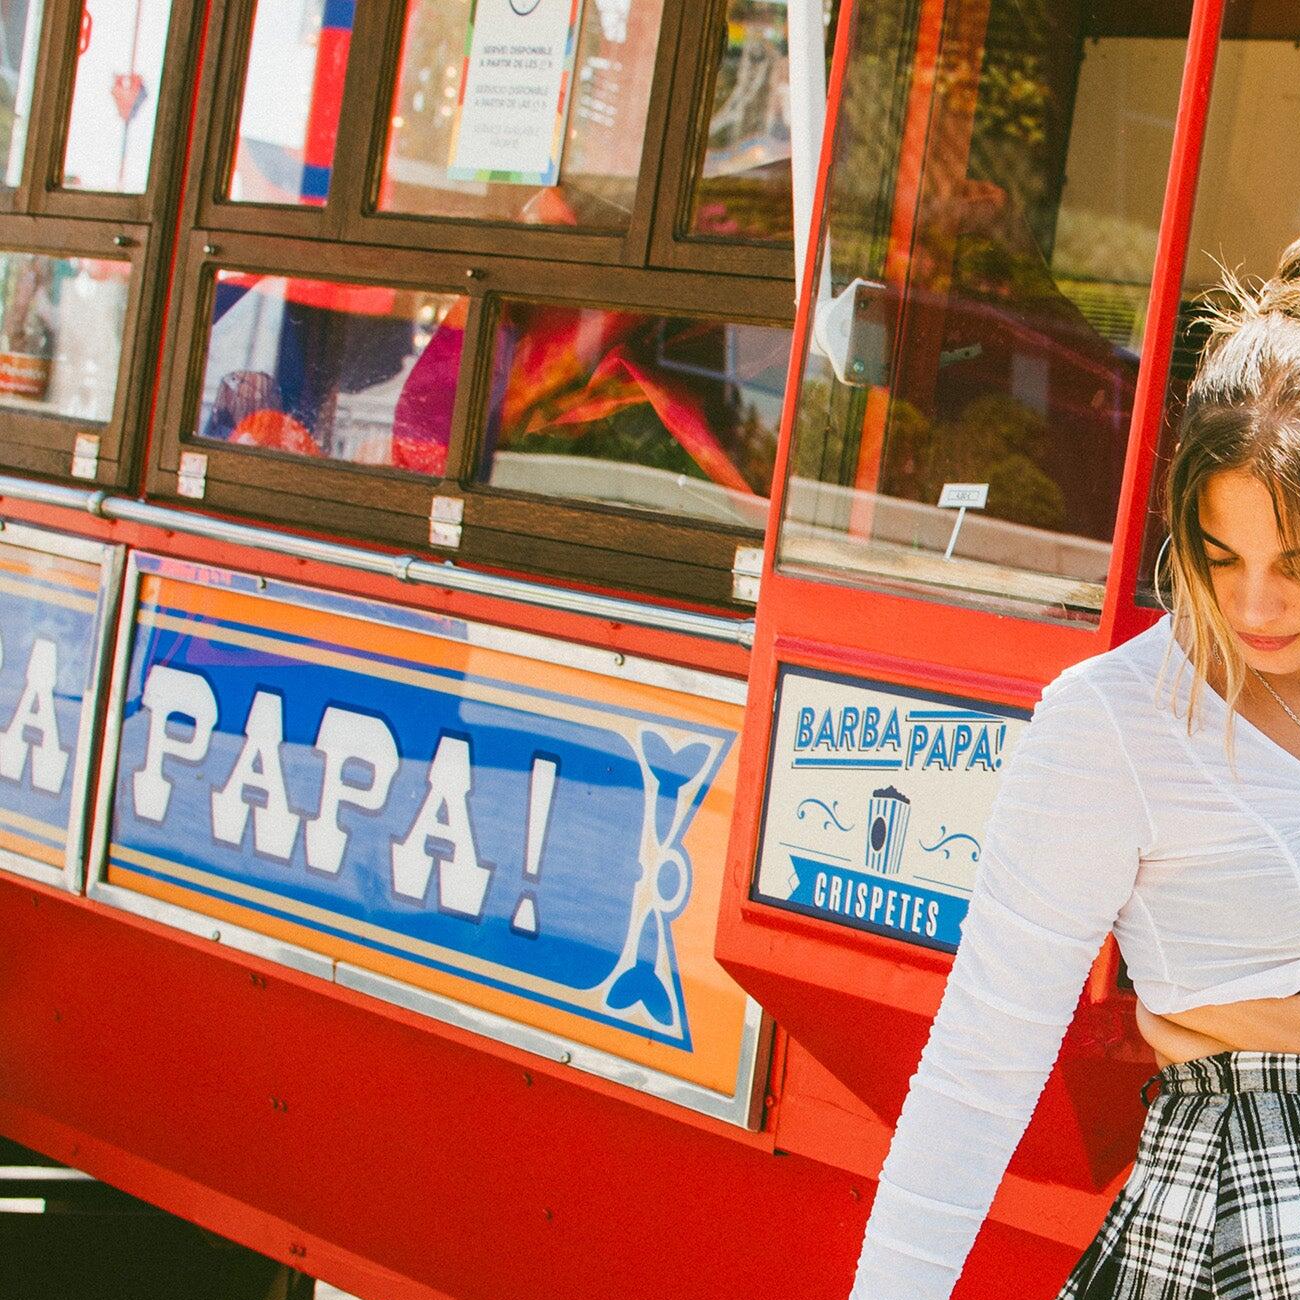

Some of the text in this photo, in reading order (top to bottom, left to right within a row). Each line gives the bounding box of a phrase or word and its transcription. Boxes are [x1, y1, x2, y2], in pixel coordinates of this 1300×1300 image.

[0, 638, 69, 793] A
[794, 706, 1007, 771] BARBA PAPA!
[133, 665, 556, 932] PAPA!
[813, 872, 940, 937] CRISPETES
